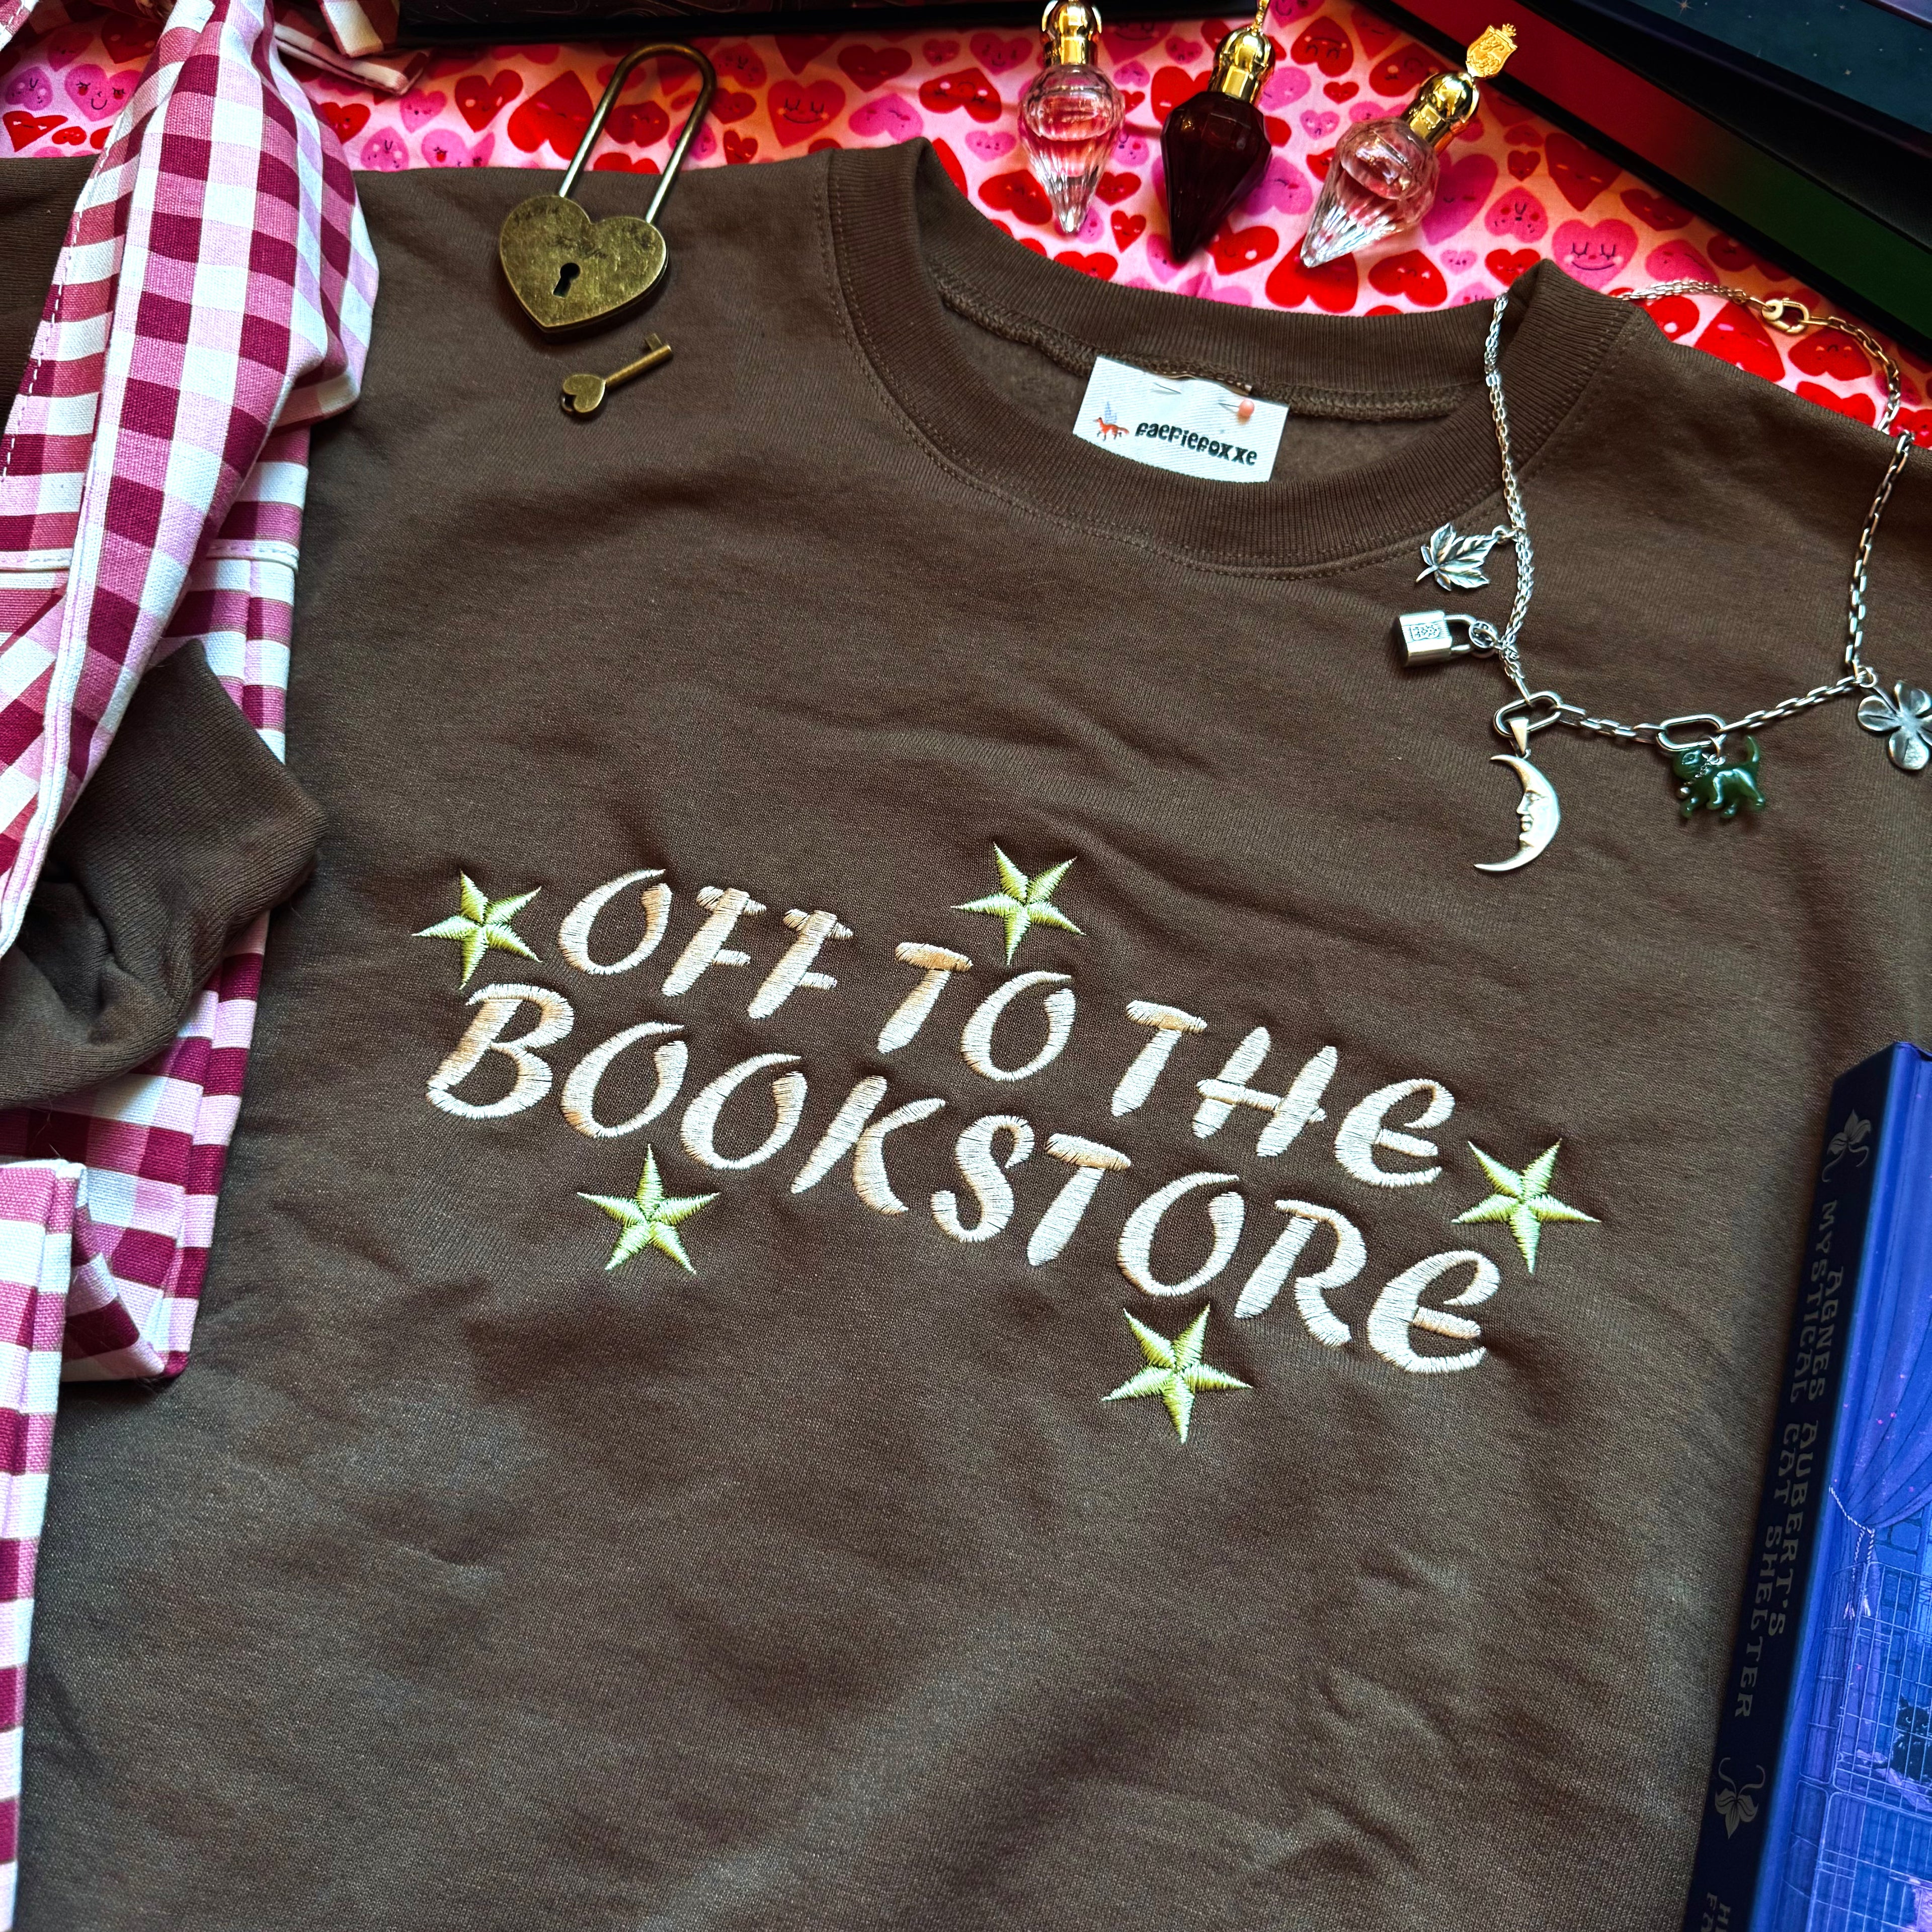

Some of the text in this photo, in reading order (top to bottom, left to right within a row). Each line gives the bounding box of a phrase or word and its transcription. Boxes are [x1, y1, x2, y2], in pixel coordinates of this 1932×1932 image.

[1136, 422, 1257, 465] faeriefoxxe
[558, 869, 853, 1020] OFF
[877, 942, 1076, 1082] TO
[1735, 1199, 1837, 1717] MYSTICAL CAT SHELTER
[1768, 1266, 1844, 1637] AGNES AUBERT'S
